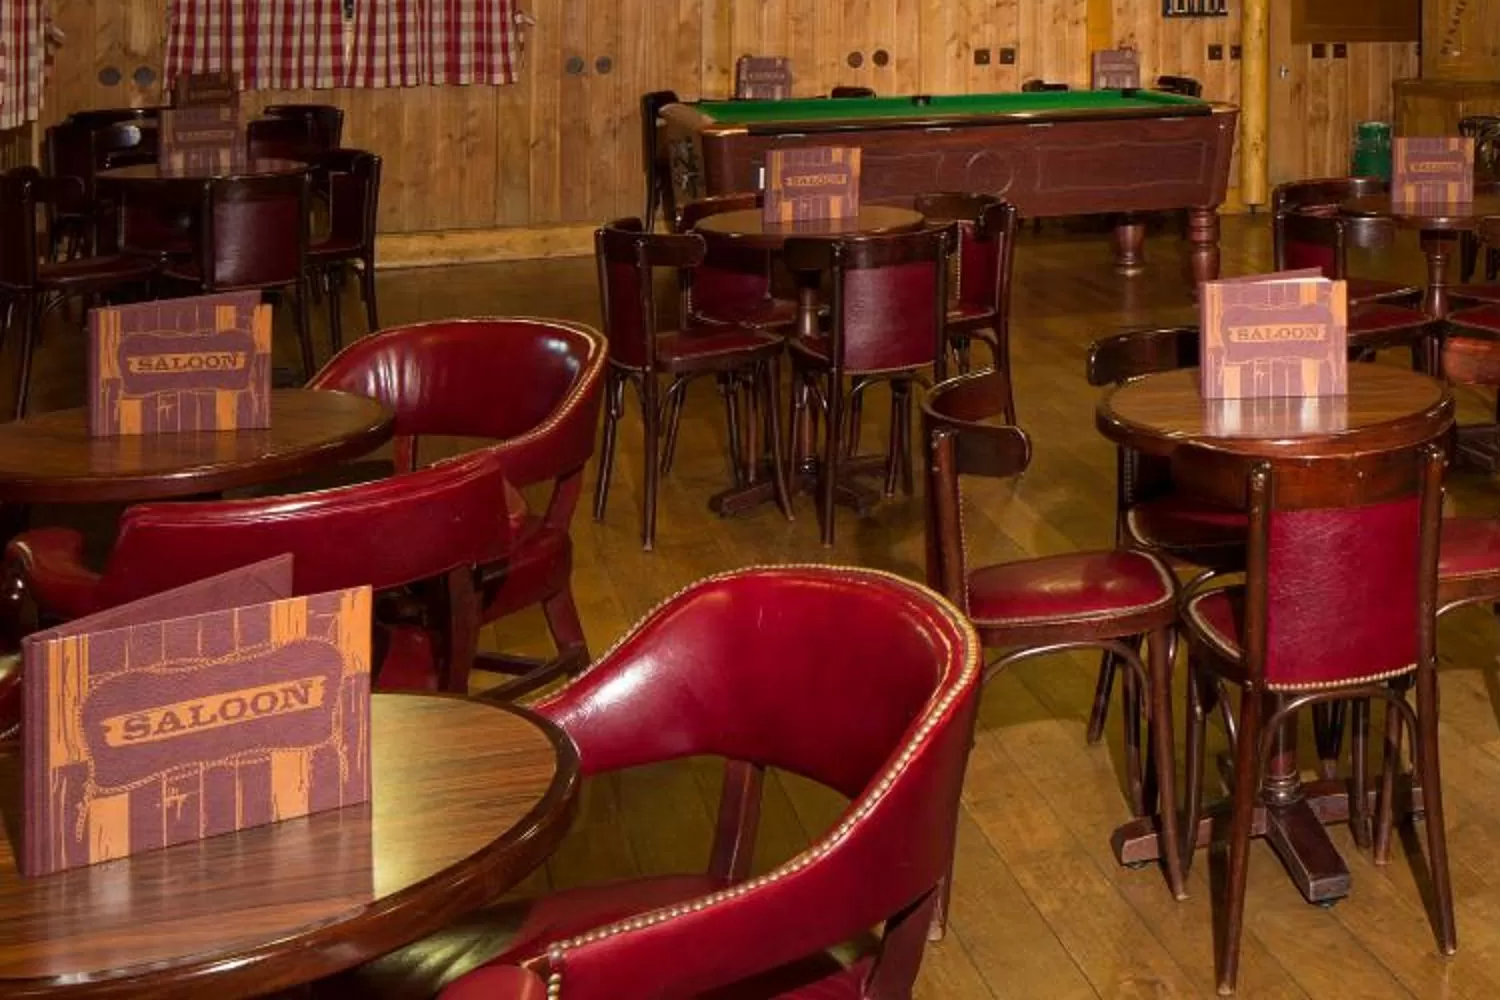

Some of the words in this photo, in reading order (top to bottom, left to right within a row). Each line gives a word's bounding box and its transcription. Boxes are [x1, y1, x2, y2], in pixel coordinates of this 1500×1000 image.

[1237, 327, 1319, 341] SALOON
[137, 353, 239, 371] SALOON
[123, 678, 313, 741] SALOON
